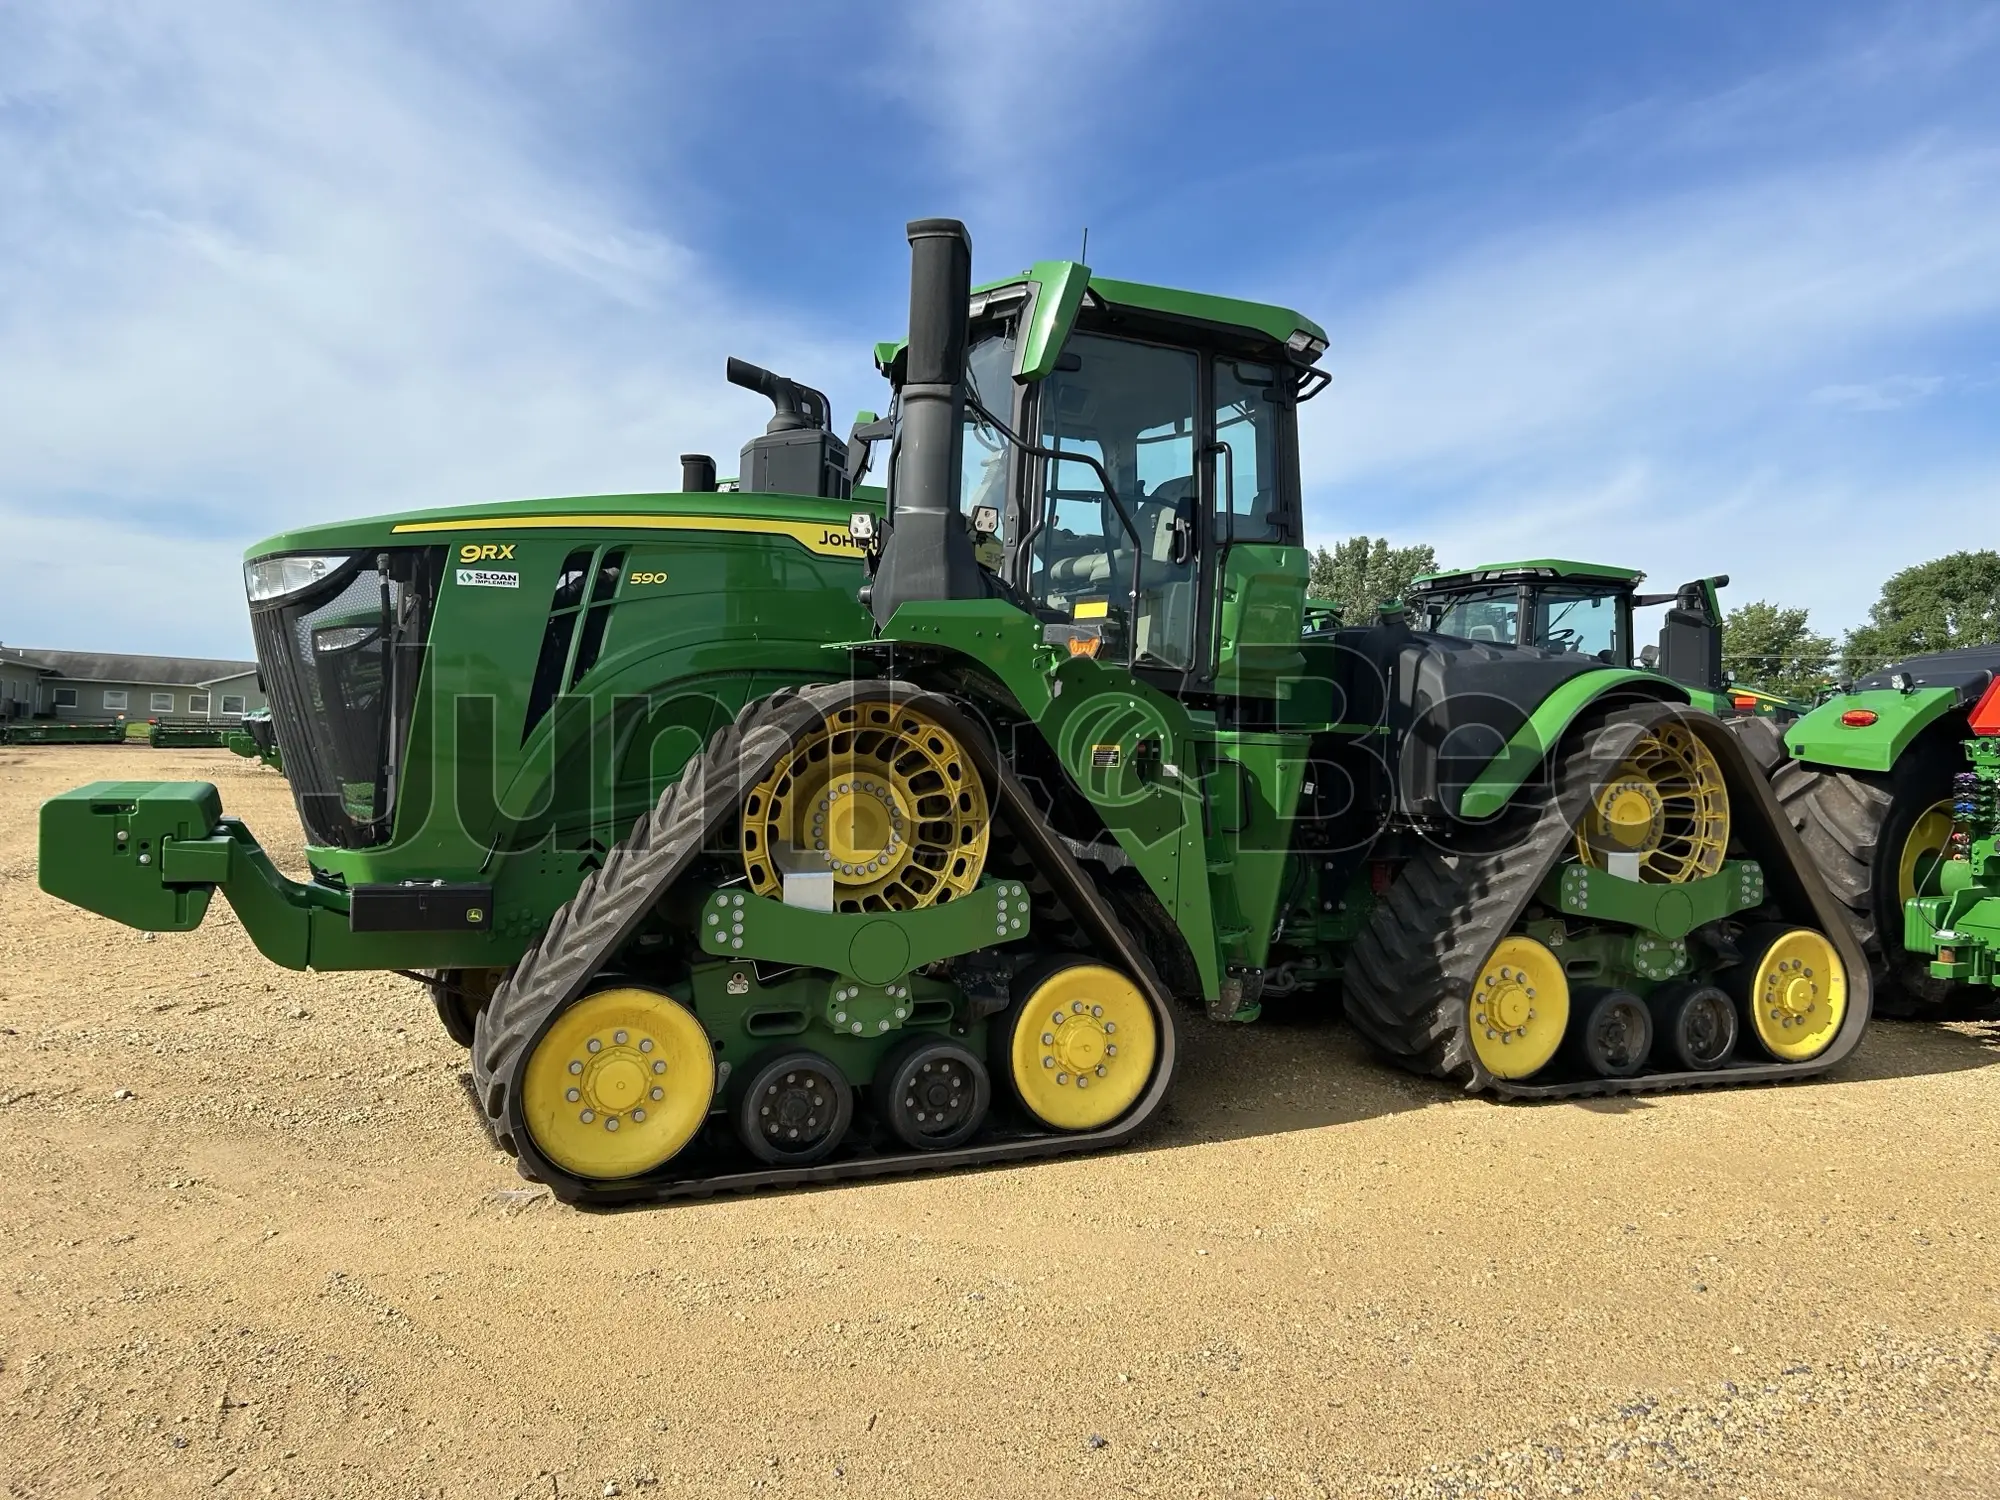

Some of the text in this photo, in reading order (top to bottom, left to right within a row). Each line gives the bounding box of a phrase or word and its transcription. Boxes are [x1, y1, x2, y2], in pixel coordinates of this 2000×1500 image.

[460, 544, 516, 563] 9RX
[475, 572, 517, 581] SLOAN
[630, 572, 668, 585] 590
[475, 579, 517, 587] IMPLEMENT
